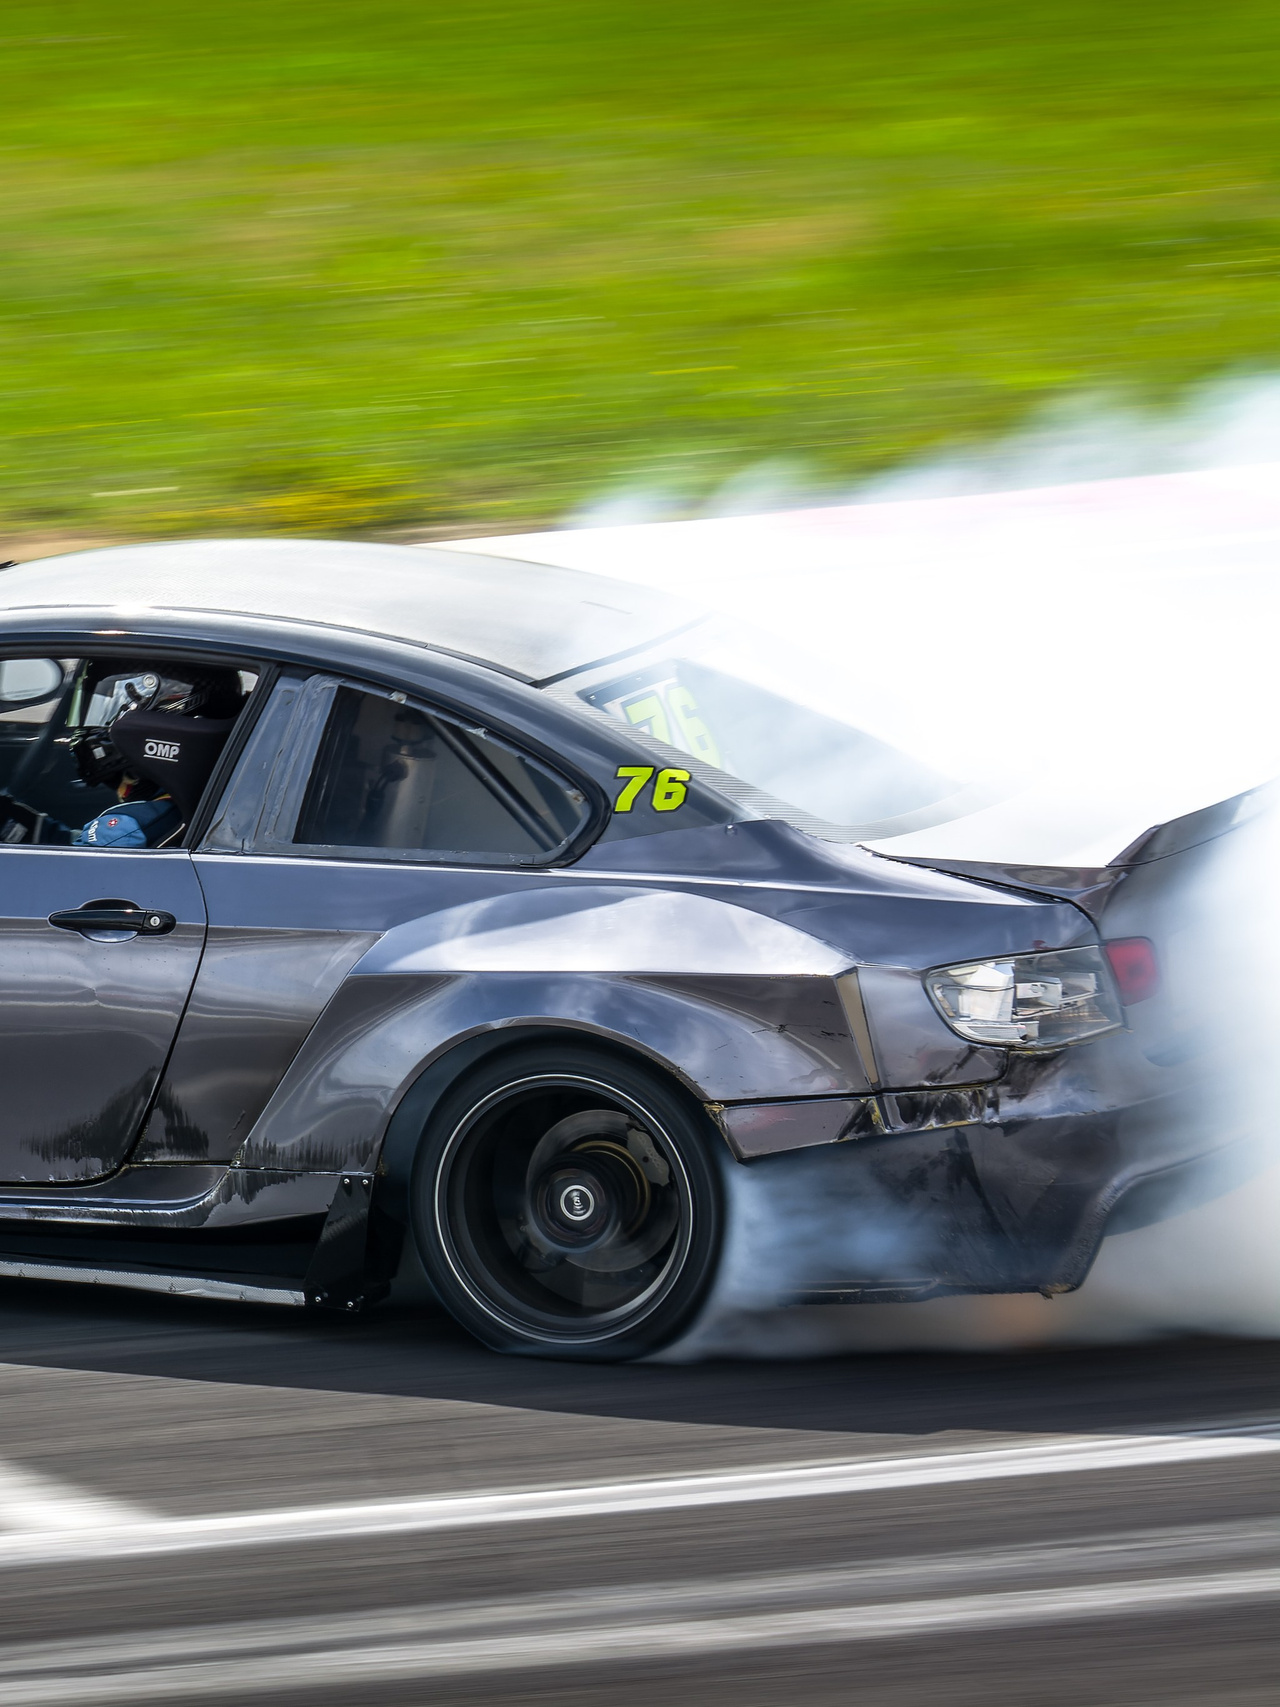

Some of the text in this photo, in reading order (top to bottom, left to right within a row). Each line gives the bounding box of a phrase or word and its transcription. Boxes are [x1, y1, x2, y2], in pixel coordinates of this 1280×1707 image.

[144, 741, 180, 759] OMP
[624, 686, 722, 769] 76
[614, 766, 691, 813] 76
